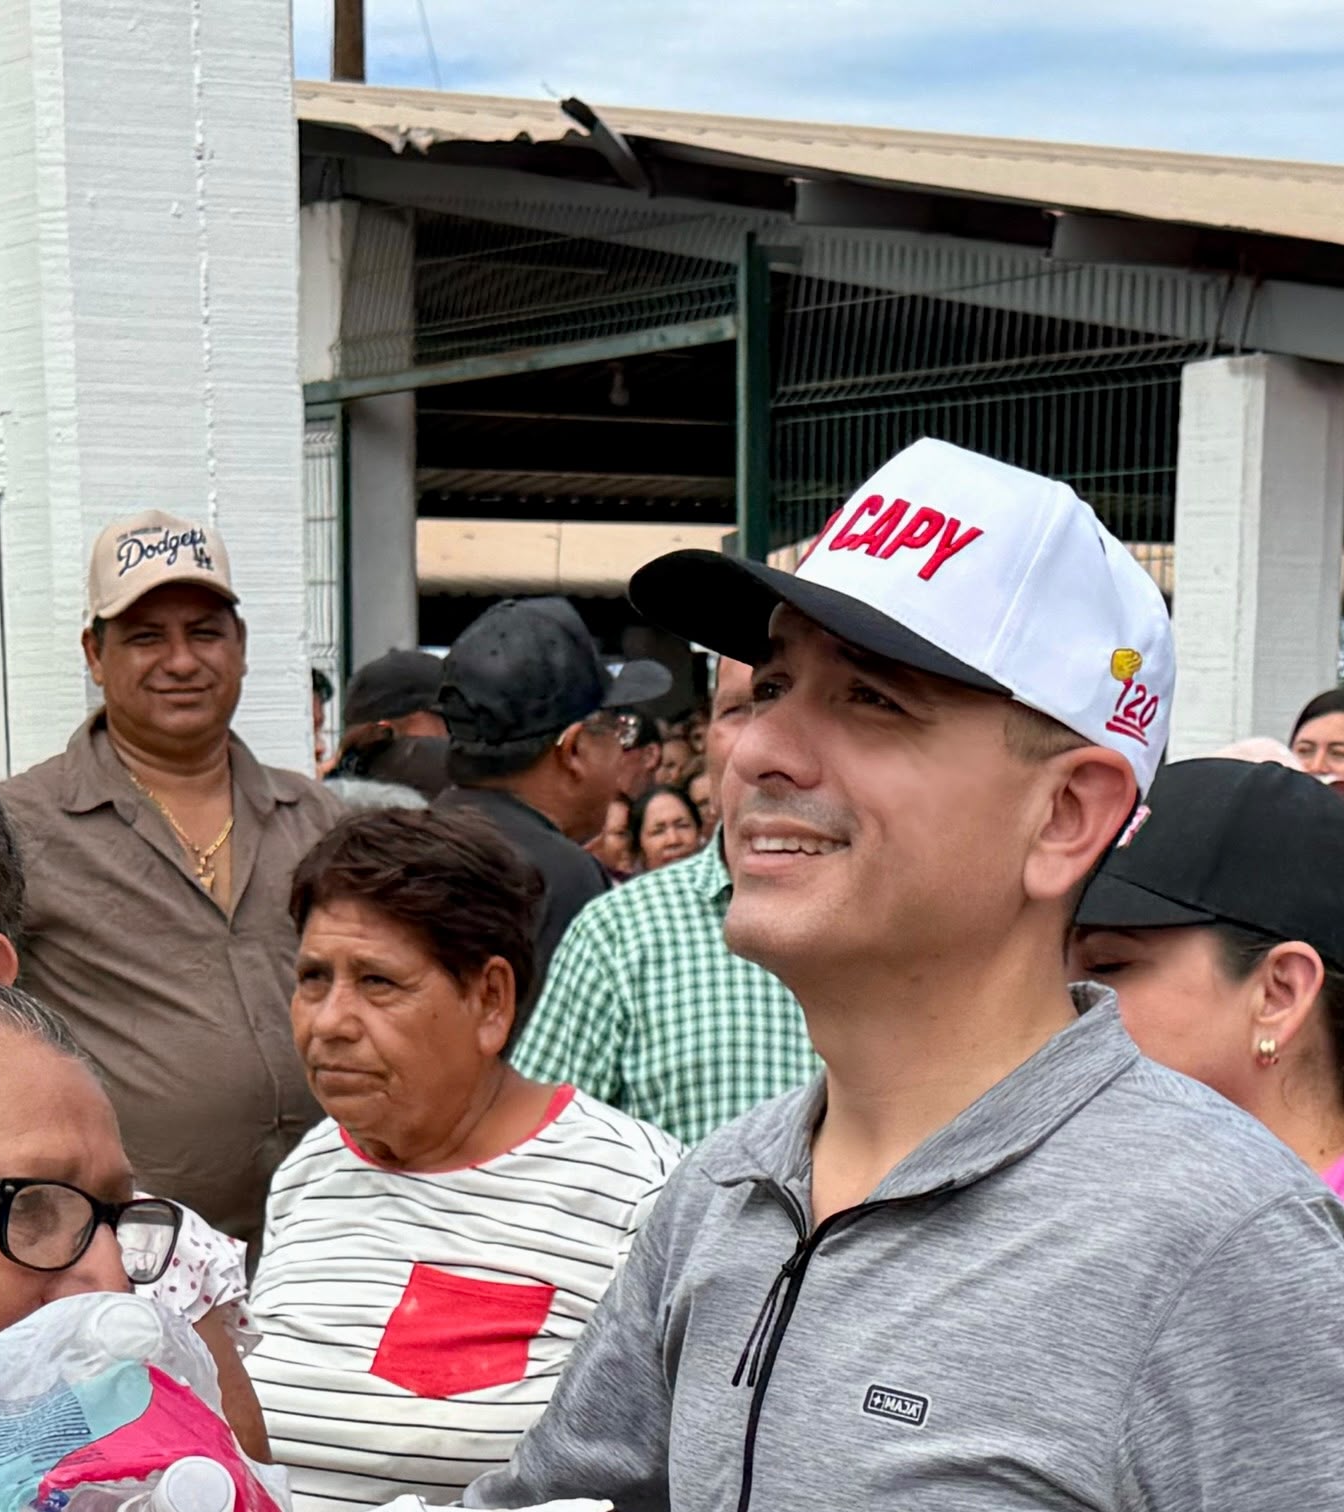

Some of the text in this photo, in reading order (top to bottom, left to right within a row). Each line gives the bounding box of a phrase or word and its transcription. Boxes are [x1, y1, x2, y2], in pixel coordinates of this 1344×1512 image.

[117, 528, 207, 577] Dodgers
[828, 494, 985, 582] CAPY
[1114, 678, 1160, 730] 120
